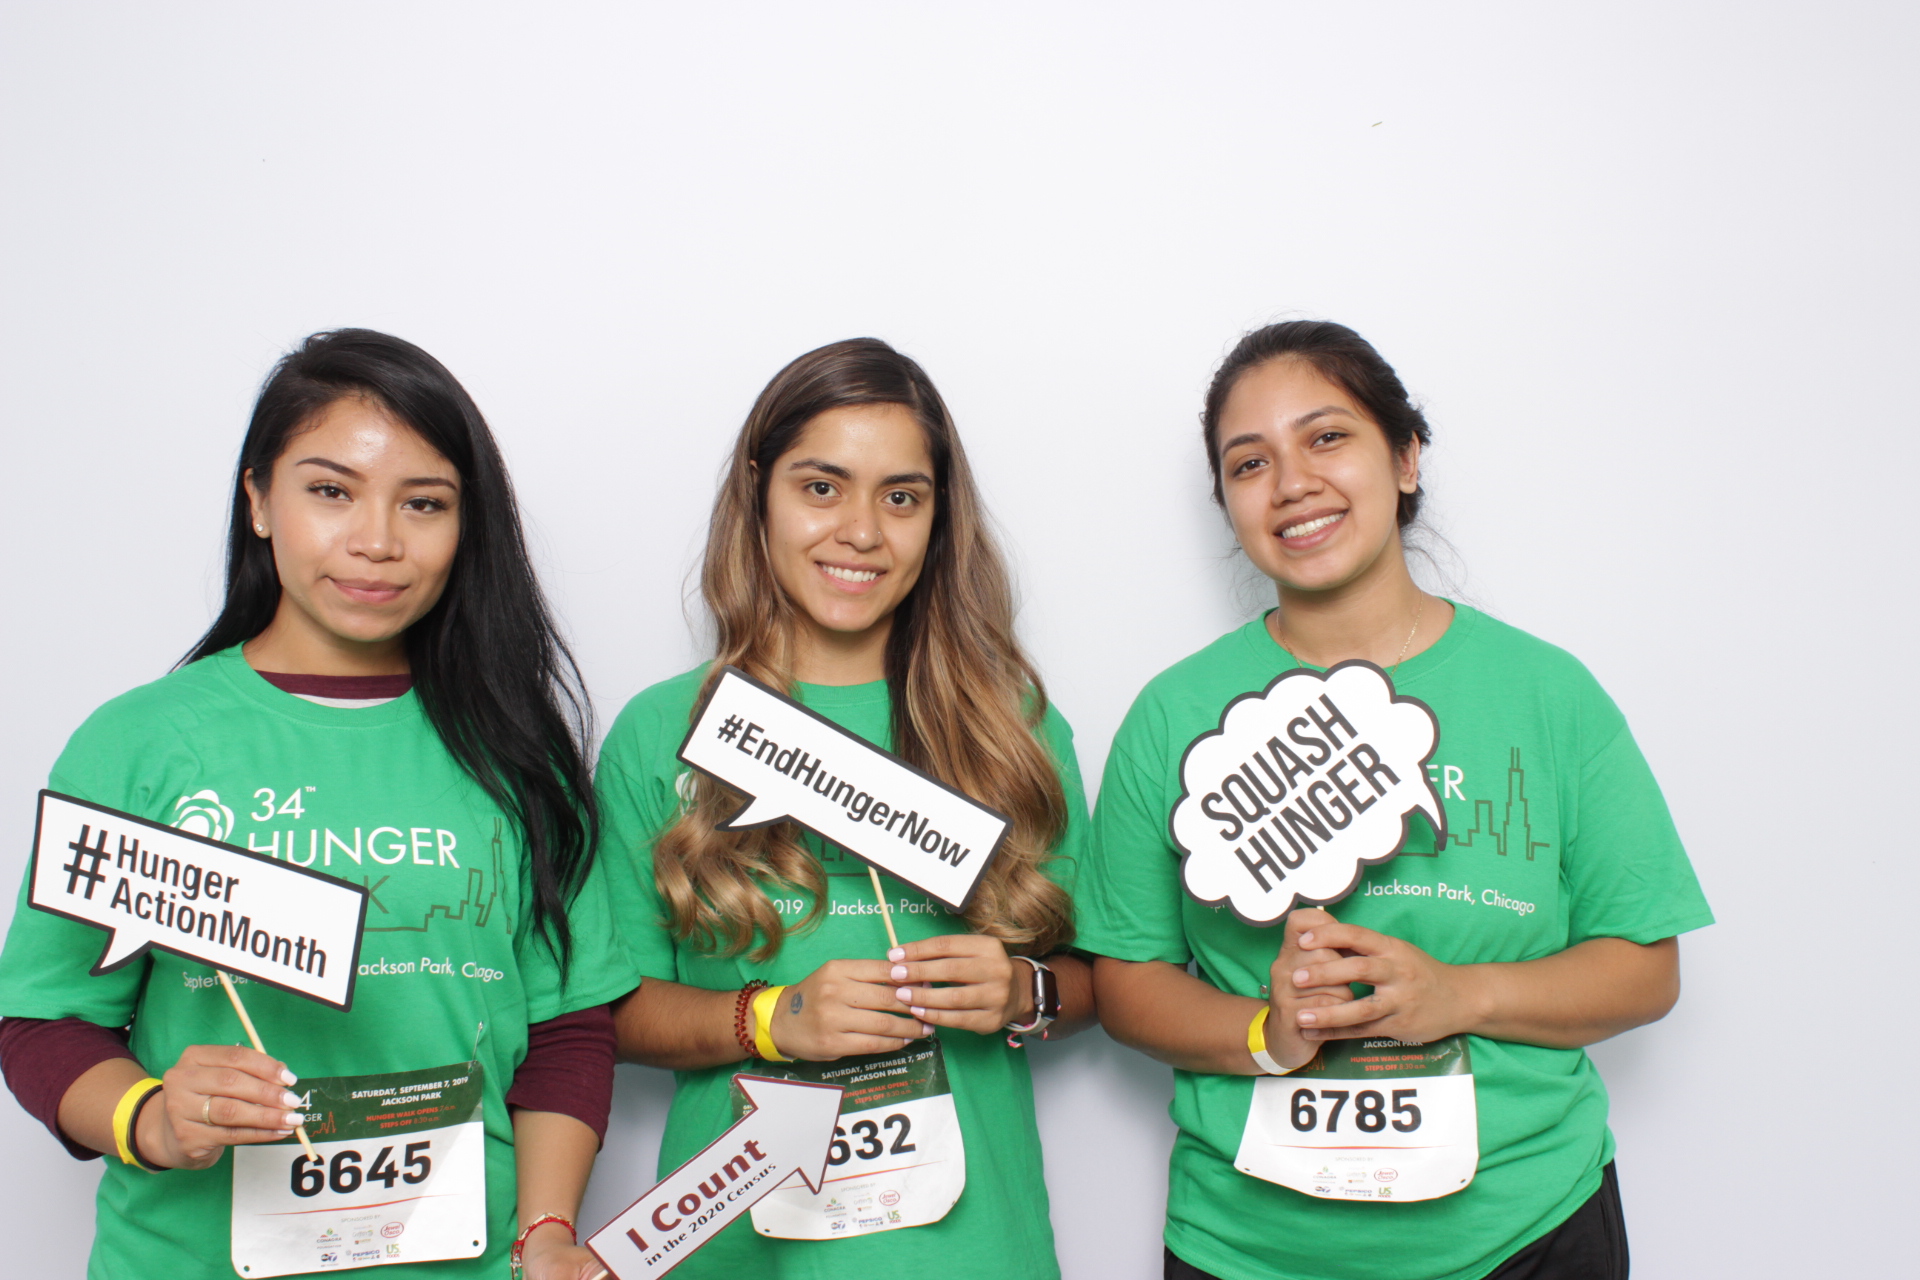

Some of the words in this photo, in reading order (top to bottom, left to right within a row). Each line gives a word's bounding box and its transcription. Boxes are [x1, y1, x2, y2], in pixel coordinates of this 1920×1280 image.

[1200, 693, 1359, 842] SQUASH
[716, 713, 971, 868] #EndHungerNow
[1234, 742, 1402, 894] HUNGER
[247, 826, 461, 869] HUNGER
[773, 899, 804, 915] 019
[900, 897, 938, 917] Park,
[1364, 878, 1432, 897] Jackson
[1437, 882, 1476, 906] Park,
[1481, 889, 1536, 917] Chicago
[110, 876, 328, 979] ActionMonth
[357, 956, 416, 976] ackson
[419, 956, 455, 977] Park,
[1363, 1041, 1400, 1049] JACKSON
[822, 1066, 862, 1080] SATURDAY,
[865, 1058, 906, 1070] SEPTEMBER
[916, 1051, 933, 1060] 2019
[850, 1071, 886, 1083] JACKSON
[888, 1067, 907, 1076] PARK
[352, 1088, 397, 1099] SATURDAY,
[400, 1082, 442, 1094] SEPTEMBER
[452, 1077, 468, 1087] 2019
[381, 1095, 418, 1106] JACKSON
[420, 1092, 441, 1100] PARK
[855, 1096, 872, 1104] STEPS
[868, 1085, 886, 1093] WALK
[888, 1081, 908, 1089] OPENS
[304, 1113, 322, 1122] GER
[380, 1121, 399, 1129] STEPS
[1290, 1087, 1422, 1133] 6785
[827, 1112, 917, 1167] 632
[290, 1140, 432, 1198] 6645
[626, 1227, 649, 1253] I
[651, 1139, 767, 1232] Count
[644, 1252, 662, 1267] in
[662, 1232, 688, 1253] the
[688, 1201, 726, 1234] 2020
[726, 1162, 777, 1202] Census
